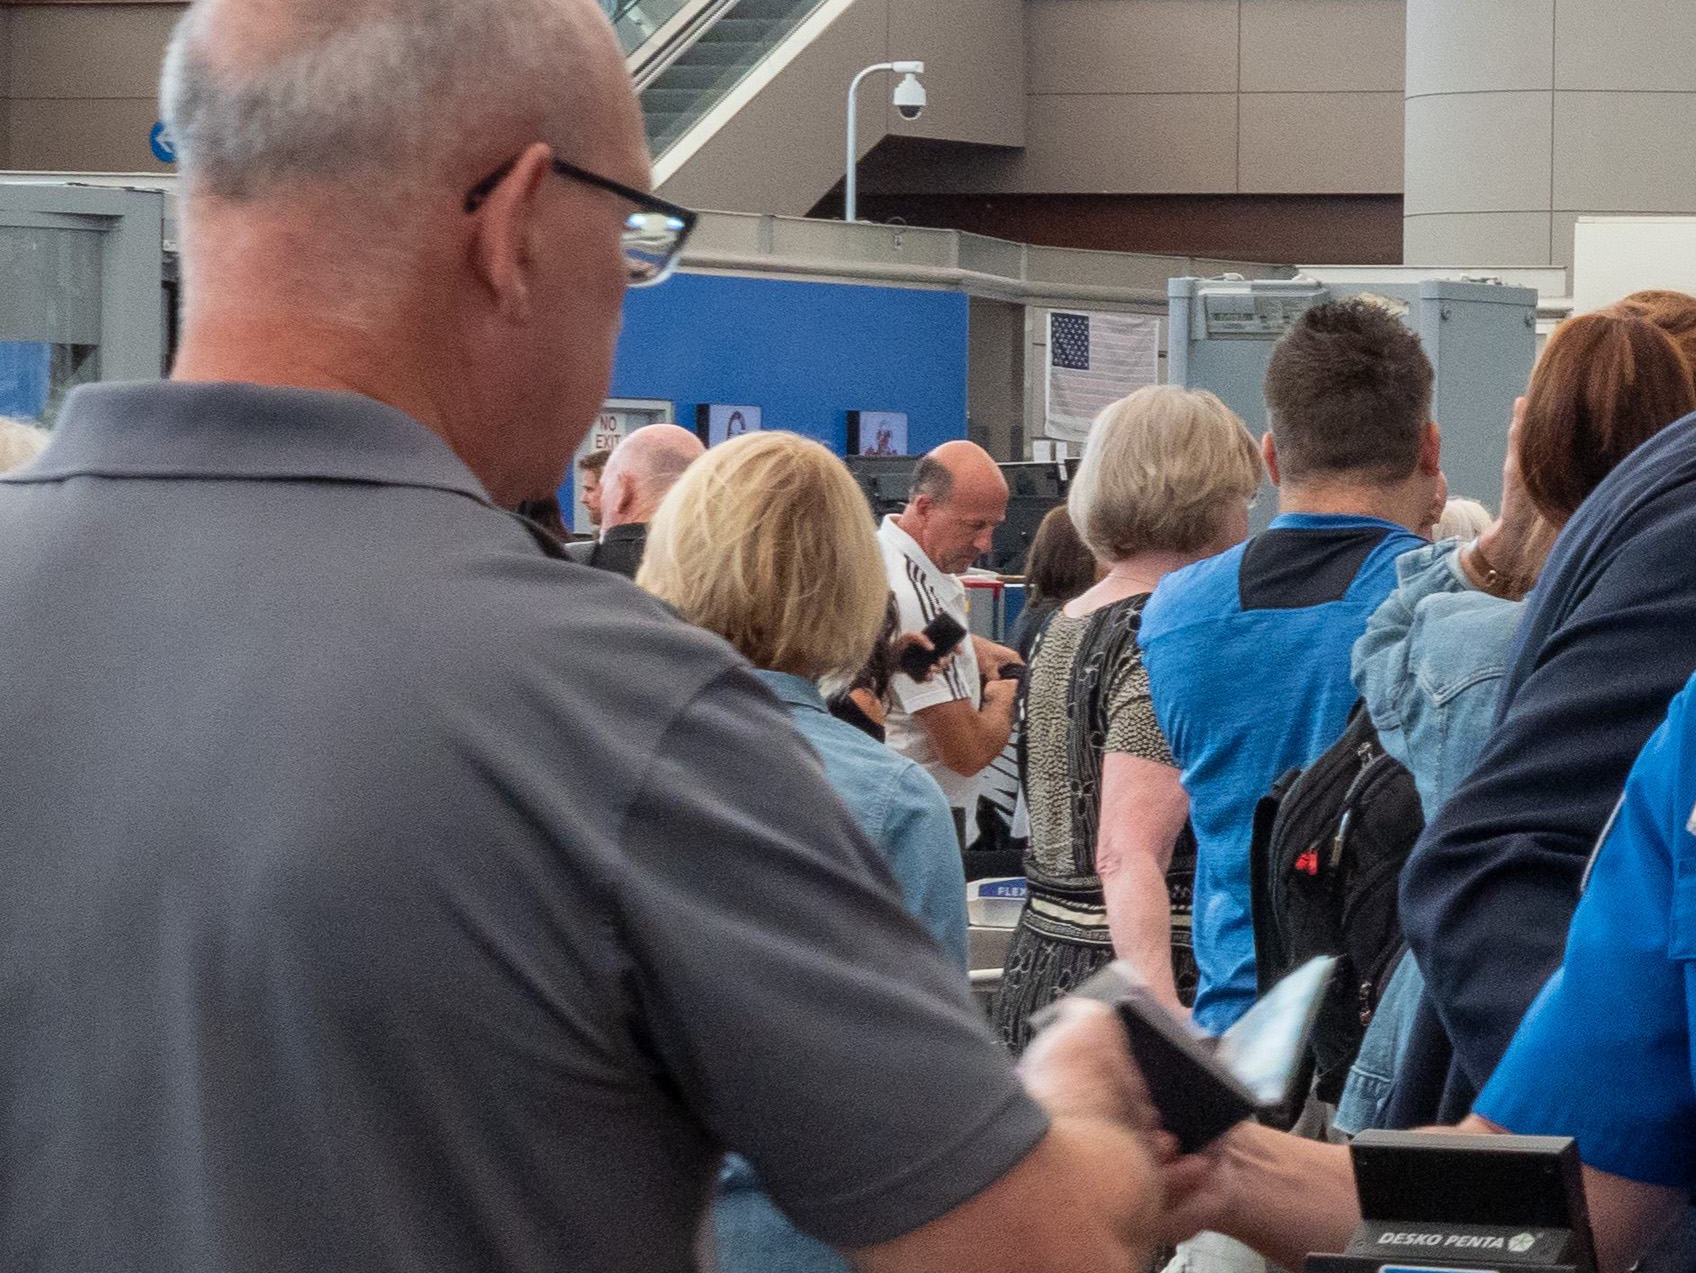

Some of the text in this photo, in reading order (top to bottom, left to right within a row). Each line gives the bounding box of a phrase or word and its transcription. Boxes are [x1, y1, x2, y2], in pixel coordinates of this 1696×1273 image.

[600, 415, 617, 431] NO
[596, 434, 621, 449] EXIT
[1378, 1232, 1504, 1249] DESKO PENTA
